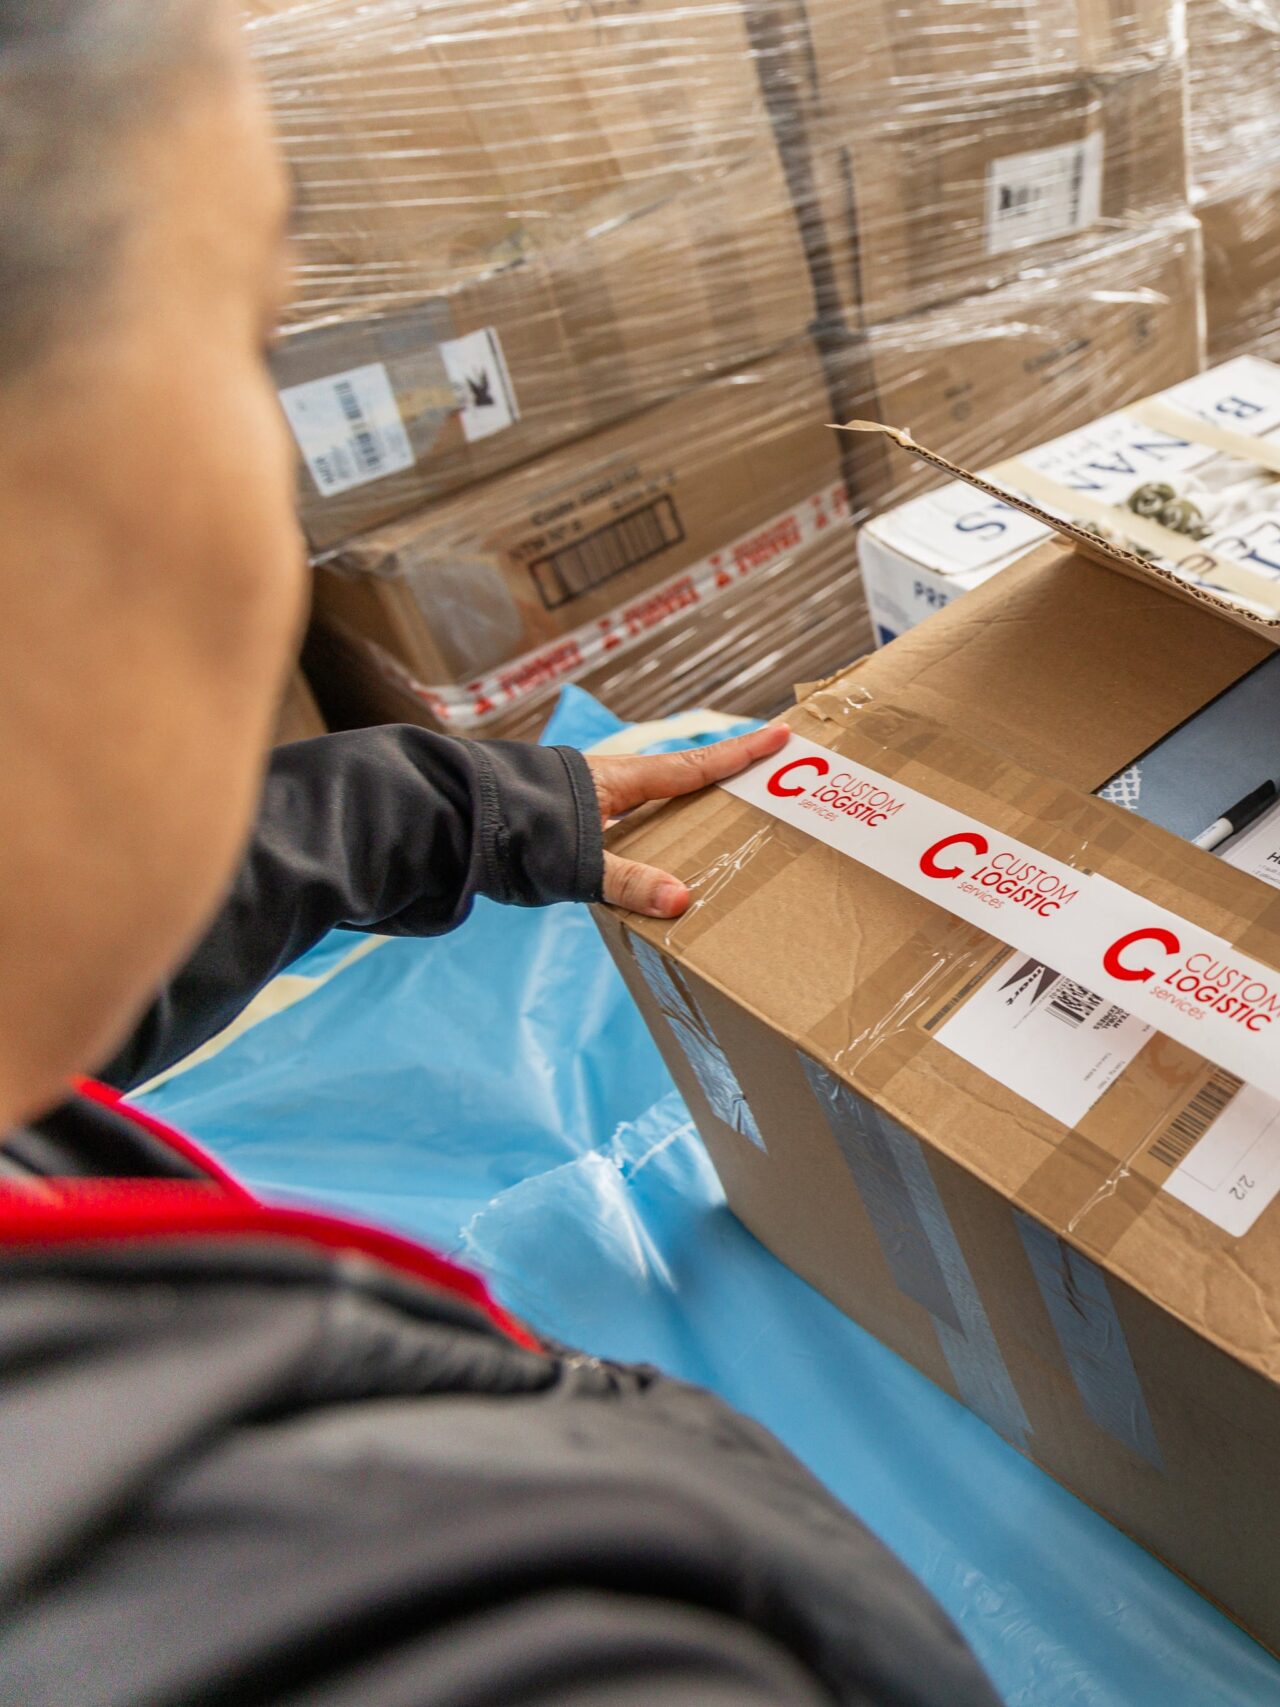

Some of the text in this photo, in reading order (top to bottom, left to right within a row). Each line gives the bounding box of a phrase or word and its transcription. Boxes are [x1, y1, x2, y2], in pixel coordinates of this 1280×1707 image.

[954, 396, 1264, 541] BNANS
[798, 799, 838, 822] services
[811, 785, 888, 827] LOGISTIC
[830, 773, 906, 815] CUSTOM
[957, 880, 1007, 909] services
[970, 866, 1061, 917] LOGISTIC
[991, 852, 1080, 905] CUSTOM
[1092, 1004, 1119, 1030] EXPRESS
[1149, 985, 1207, 1021] services
[1164, 968, 1272, 1032] LOGISTIC
[1101, 1007, 1125, 1030] GLOBAL
[1111, 1011, 1131, 1029] TEAM
[1228, 1173, 1255, 1201] 2/2
